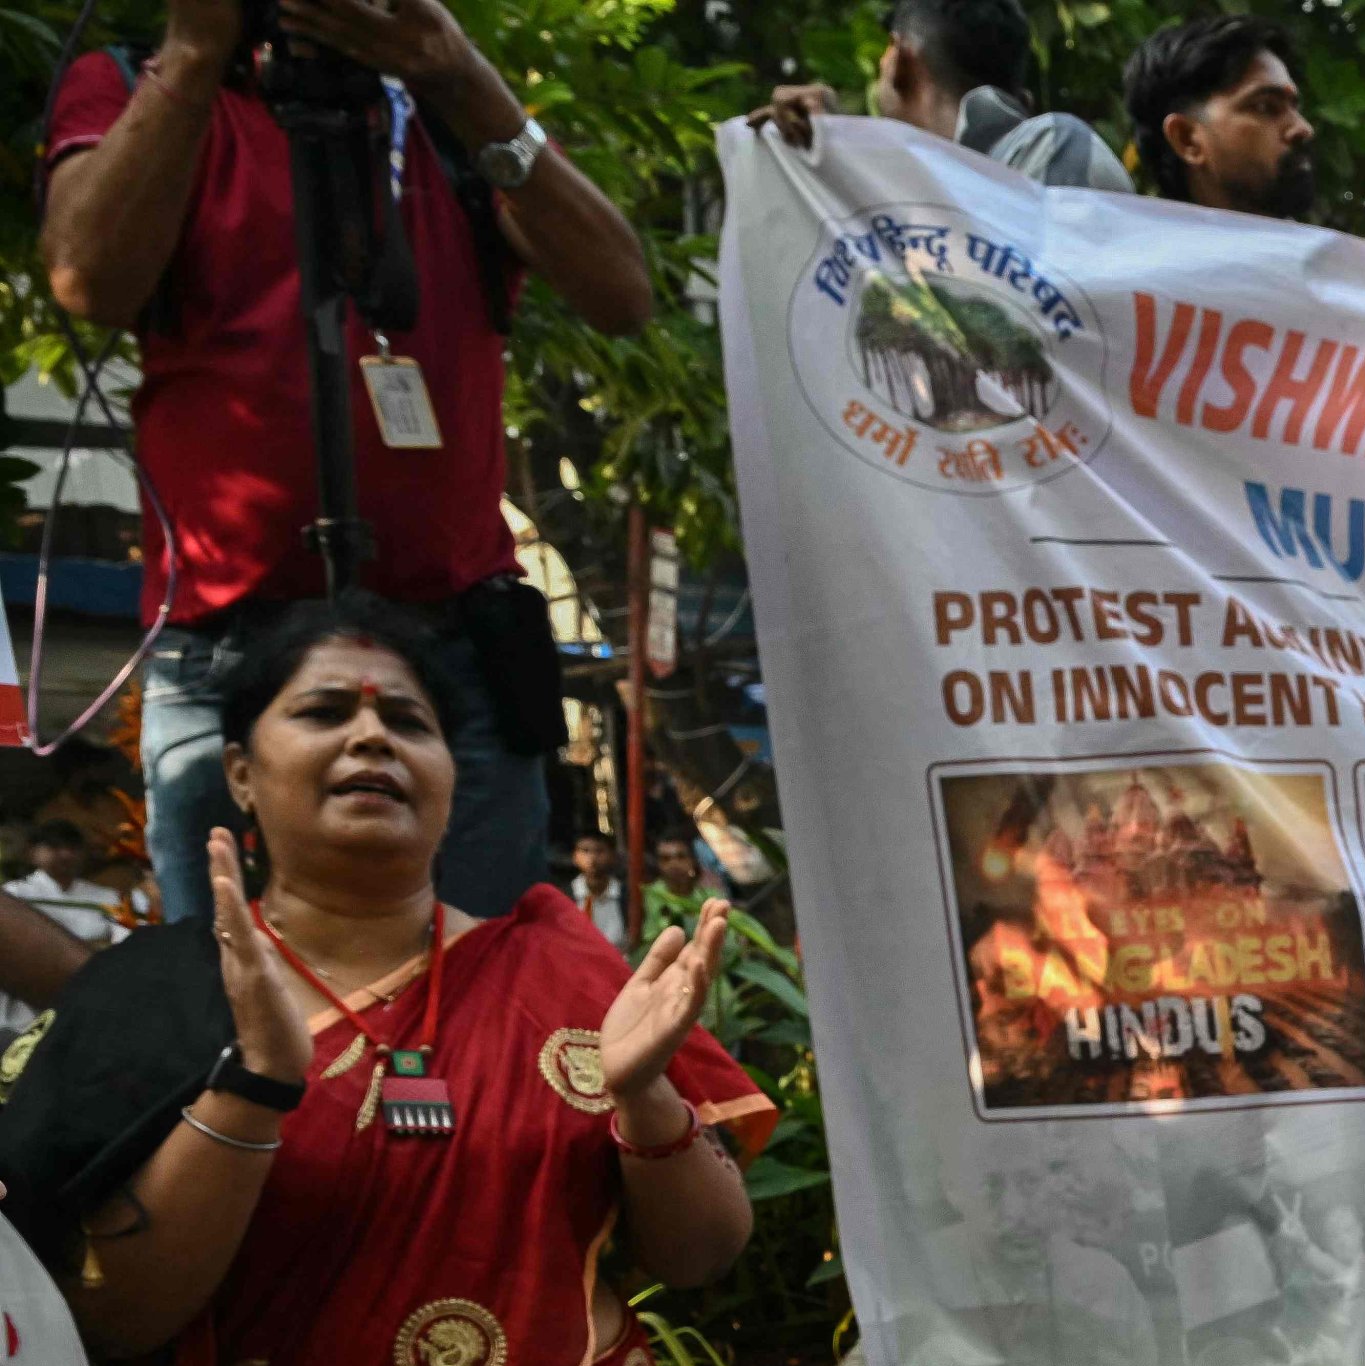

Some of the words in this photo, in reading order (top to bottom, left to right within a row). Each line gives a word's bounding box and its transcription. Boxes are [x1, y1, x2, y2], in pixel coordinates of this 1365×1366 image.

[933, 586, 1202, 647] PROTEST
[942, 667, 1036, 727] ON
[1052, 664, 1340, 728] INNOCENT
[1216, 897, 1266, 929] ON
[1065, 993, 1267, 1061] HINDUS
